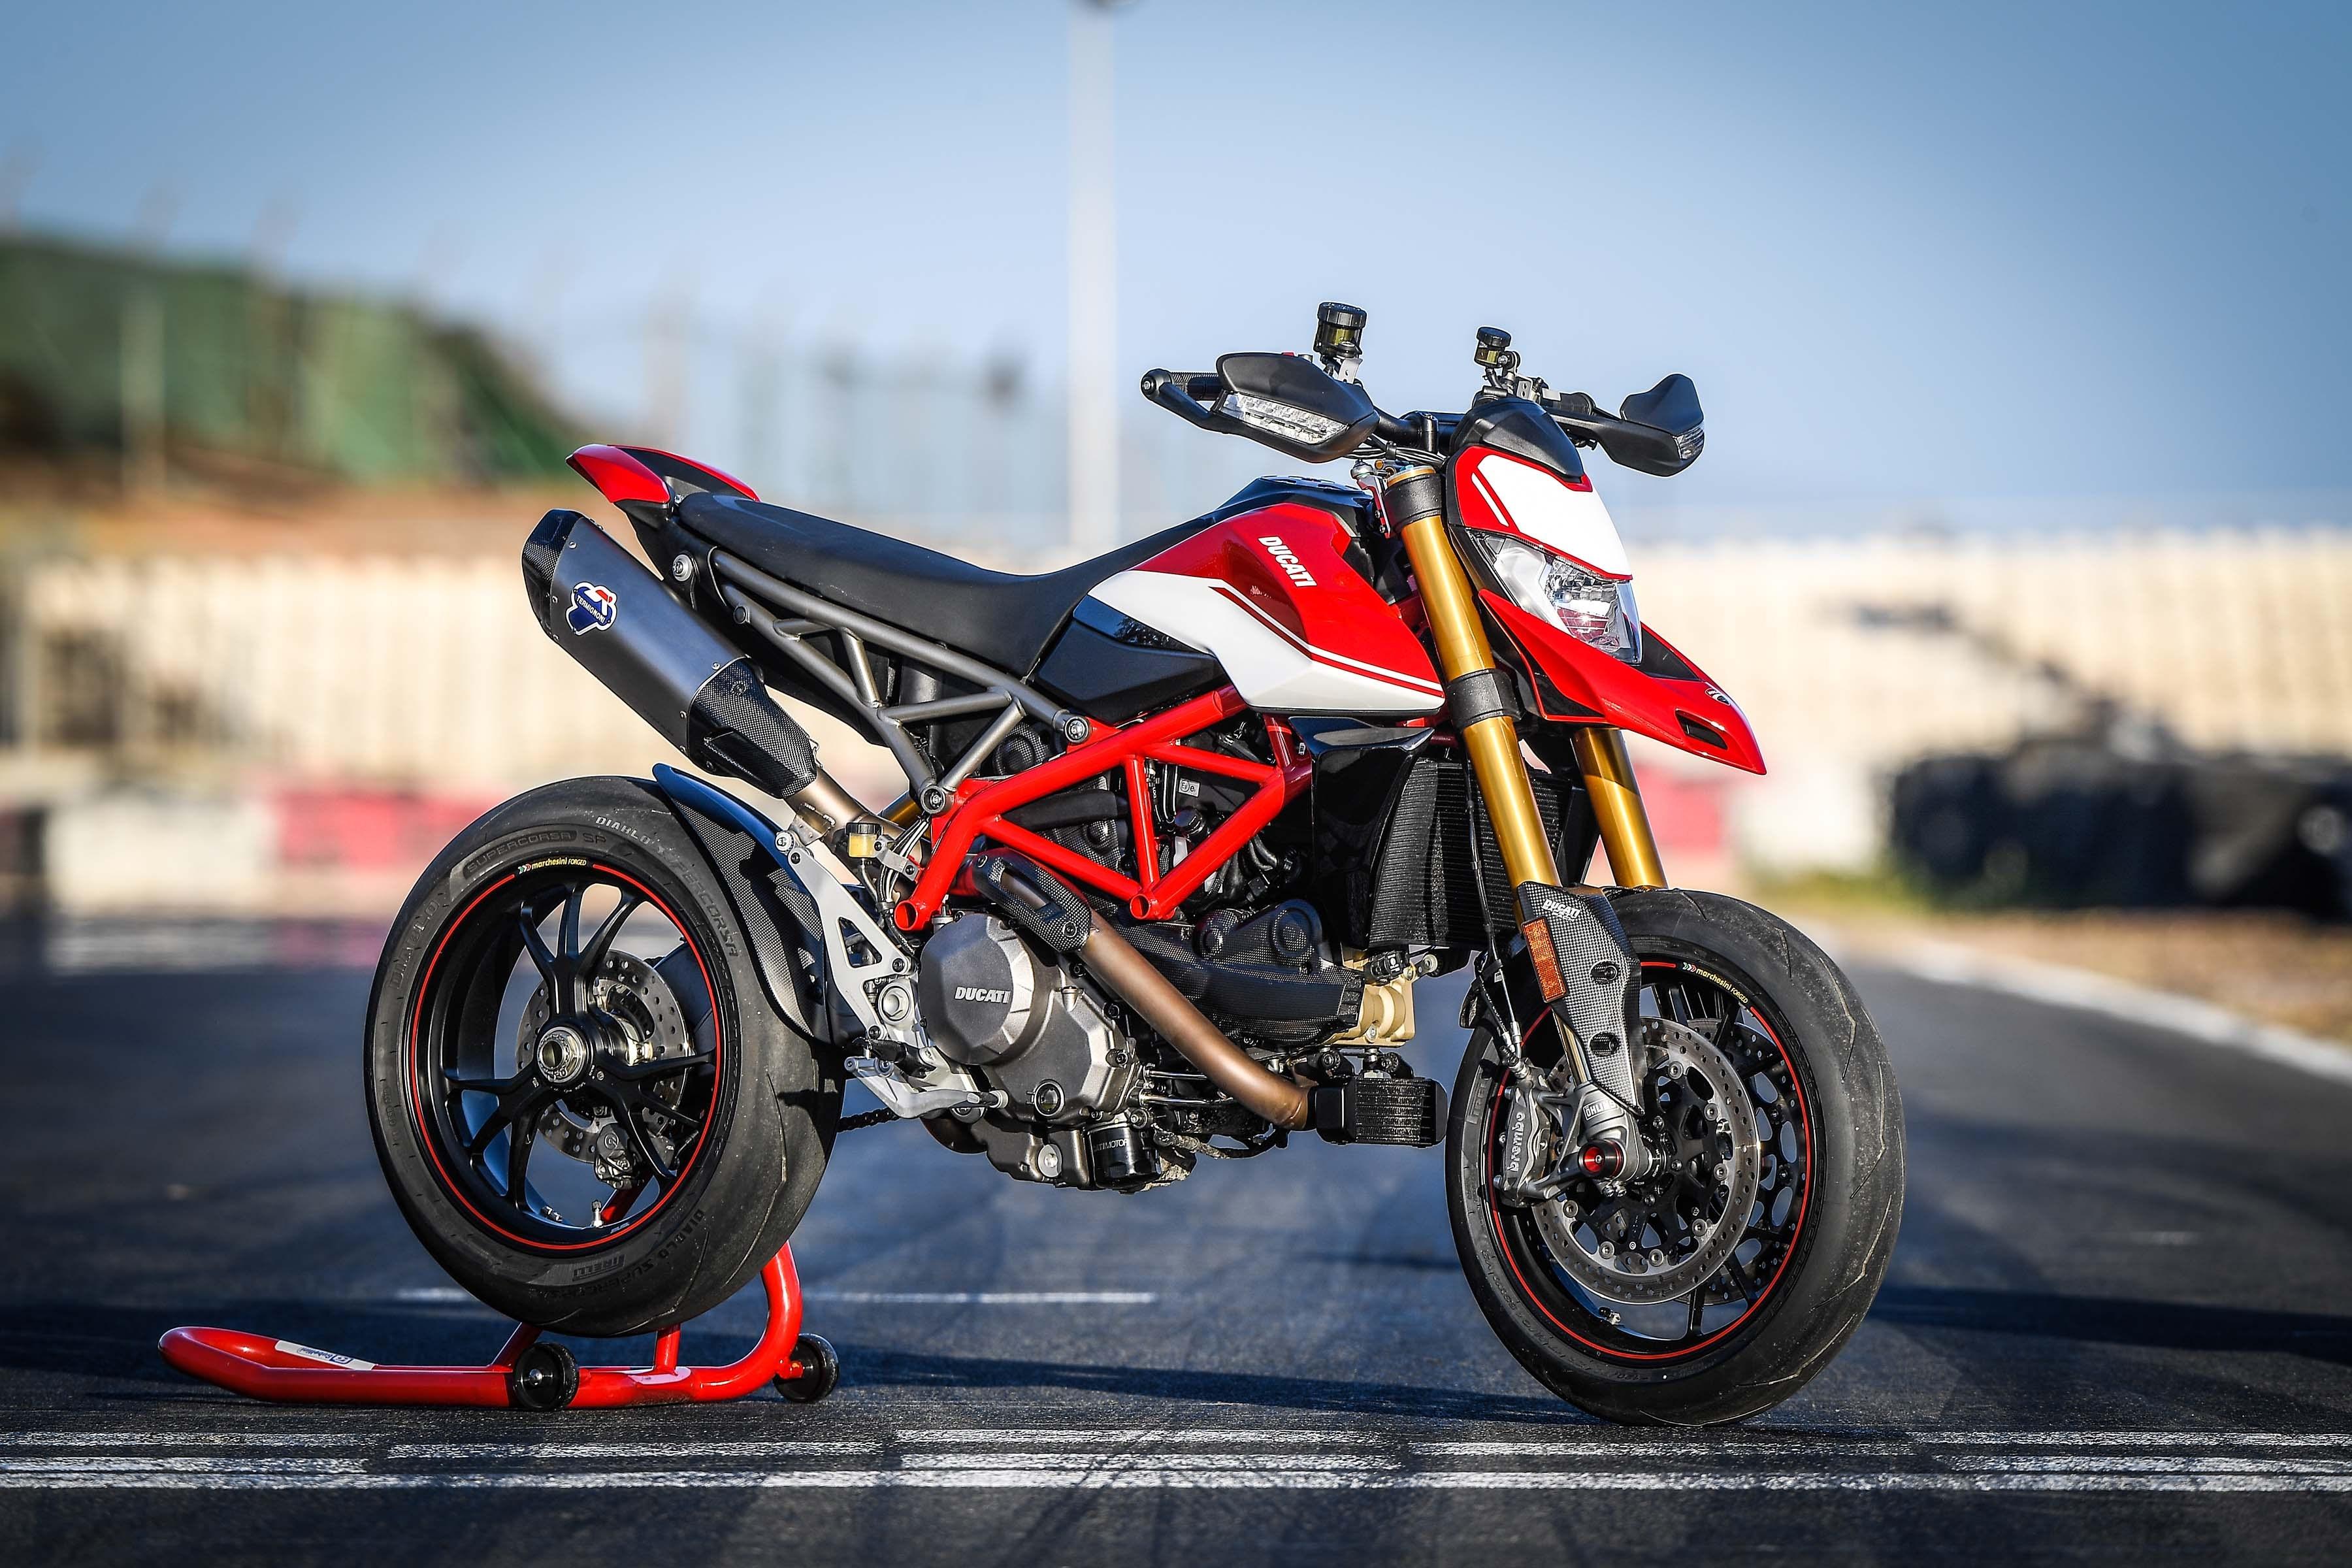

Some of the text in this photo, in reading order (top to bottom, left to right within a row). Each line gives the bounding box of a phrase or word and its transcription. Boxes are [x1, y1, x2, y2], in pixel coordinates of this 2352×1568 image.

[1258, 536, 1317, 587] DUCATI
[576, 595, 606, 624] TERMIGNONI
[595, 815, 651, 845] DIABLO
[467, 831, 607, 873] SUPERCORSA SP
[532, 857, 568, 870] marchesini
[1541, 898, 1581, 919] DUCATI
[955, 986, 1011, 1004] DUCATI
[1696, 968, 1748, 1004] marchesini FORGED
[1507, 1111, 1526, 1173] brembo
[659, 1208, 705, 1260] DIABLO
[572, 1254, 627, 1282] PIRELLI
